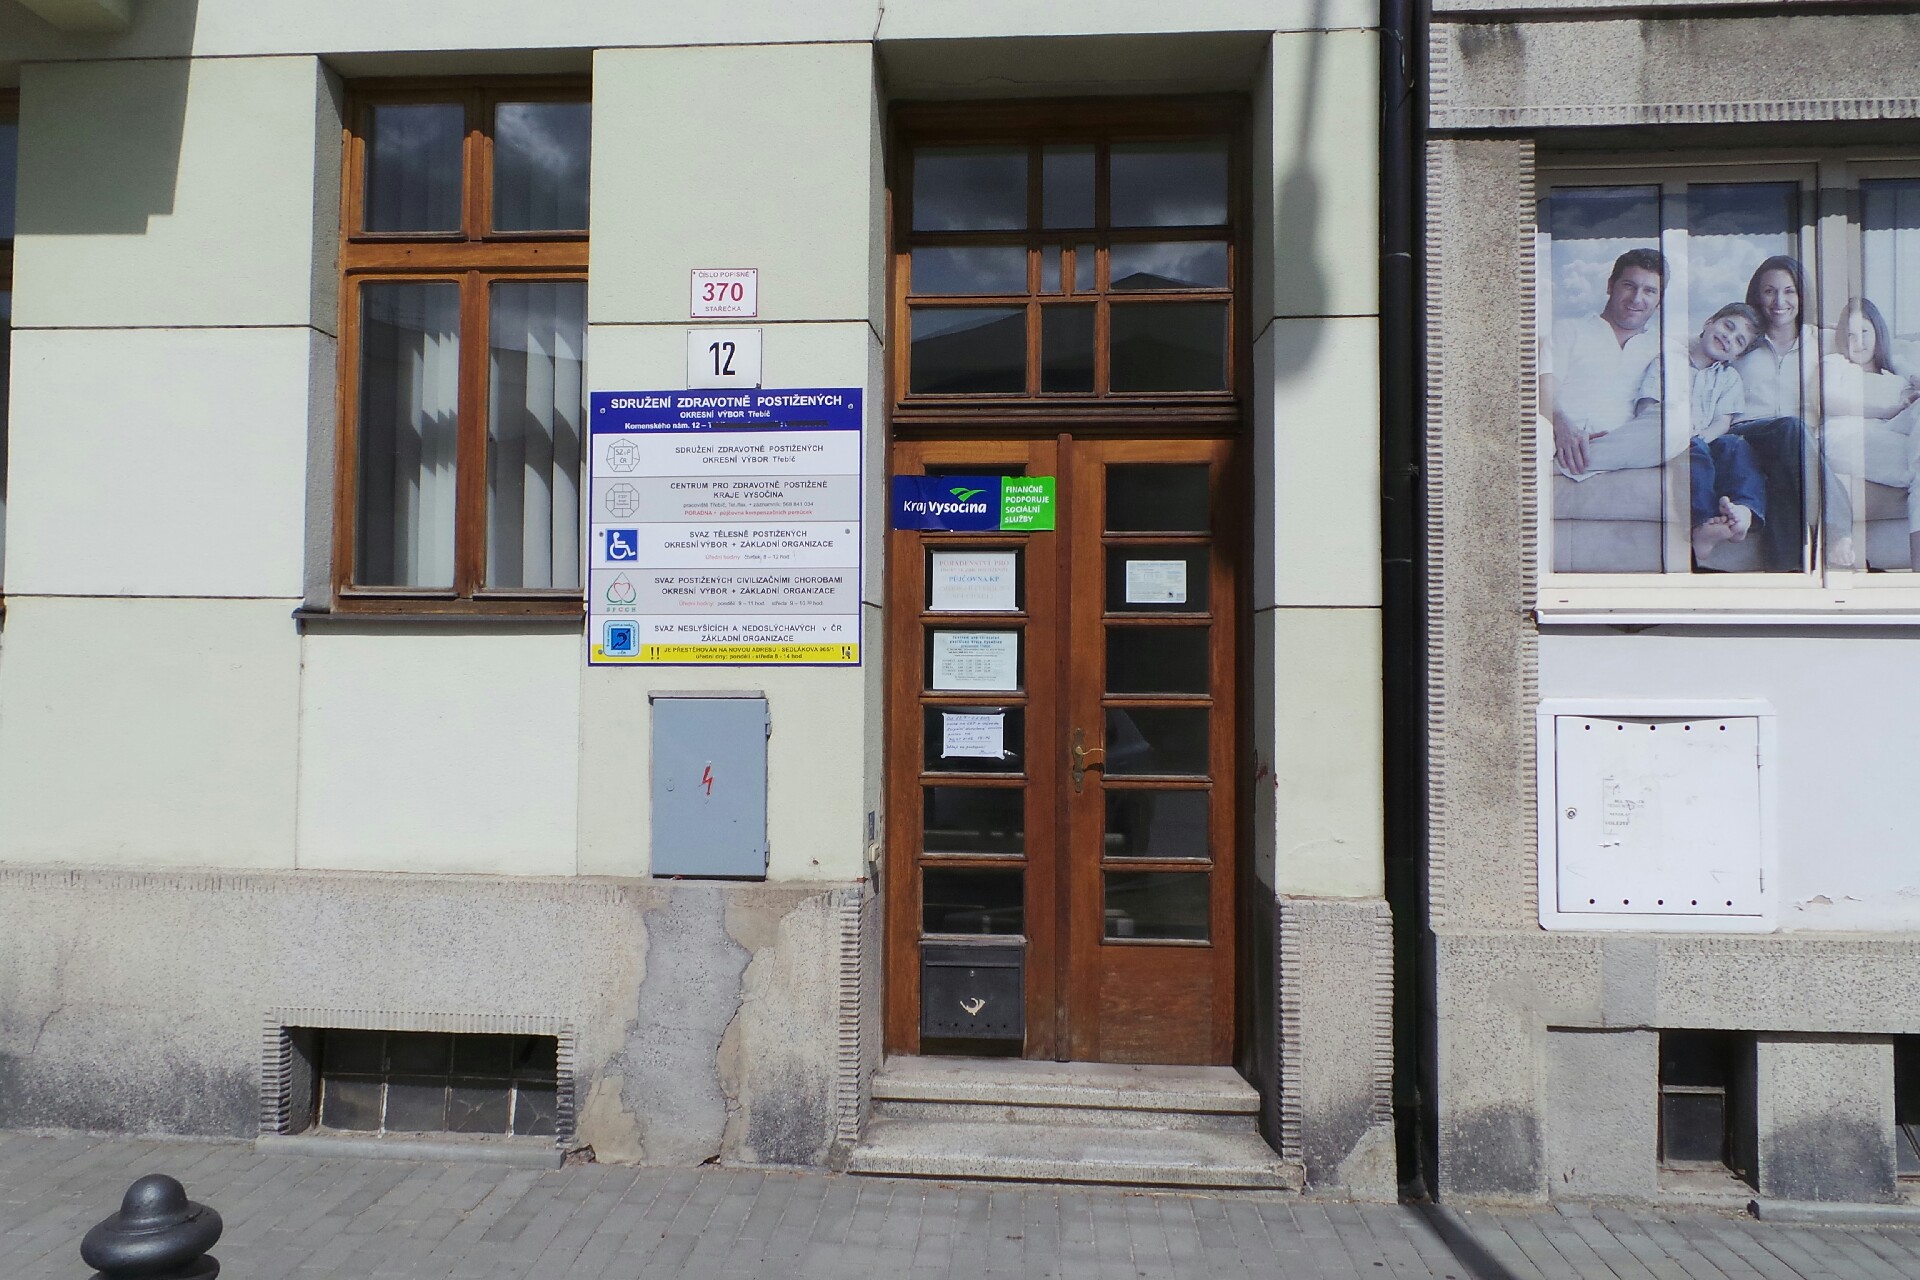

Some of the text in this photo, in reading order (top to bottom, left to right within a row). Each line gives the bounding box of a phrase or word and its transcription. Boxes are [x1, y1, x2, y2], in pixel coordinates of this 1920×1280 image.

[720, 270, 749, 278] POPISNÉ
[702, 282, 744, 301] 370
[709, 342, 736, 376] 12
[610, 393, 842, 408] SDRUŽENÍ ZDRAVOTNĚ POSTIŽENÝCH
[680, 410, 770, 418] OKRESNÍ VÝBOR Třebíč
[624, 422, 671, 430] Komenského
[676, 444, 823, 453] SDRUŽENÍ ZDRAVOTNĚ POSTIŽENÝCH
[702, 455, 796, 463] OKRESNÍ VÝBOR Třebíč
[733, 480, 780, 488] ZDRAVOTNĚ
[784, 480, 827, 488] POSTIŽENÉ
[1006, 484, 1043, 493] FINANČNĚ
[903, 500, 926, 515] Kraj
[1006, 505, 1040, 513] SOCIÁLNÍ
[1005, 515, 1033, 523] SLUŽBY
[753, 529, 807, 537] POSTIŽENÝCH
[664, 540, 698, 548] OKRESNÍ
[701, 540, 728, 548] VÝBOR
[741, 540, 780, 548] ZÁKLADNÍ
[737, 575, 790, 583] CIVILIZAČNÍMI
[701, 634, 740, 642] ZÁKLADNÍ
